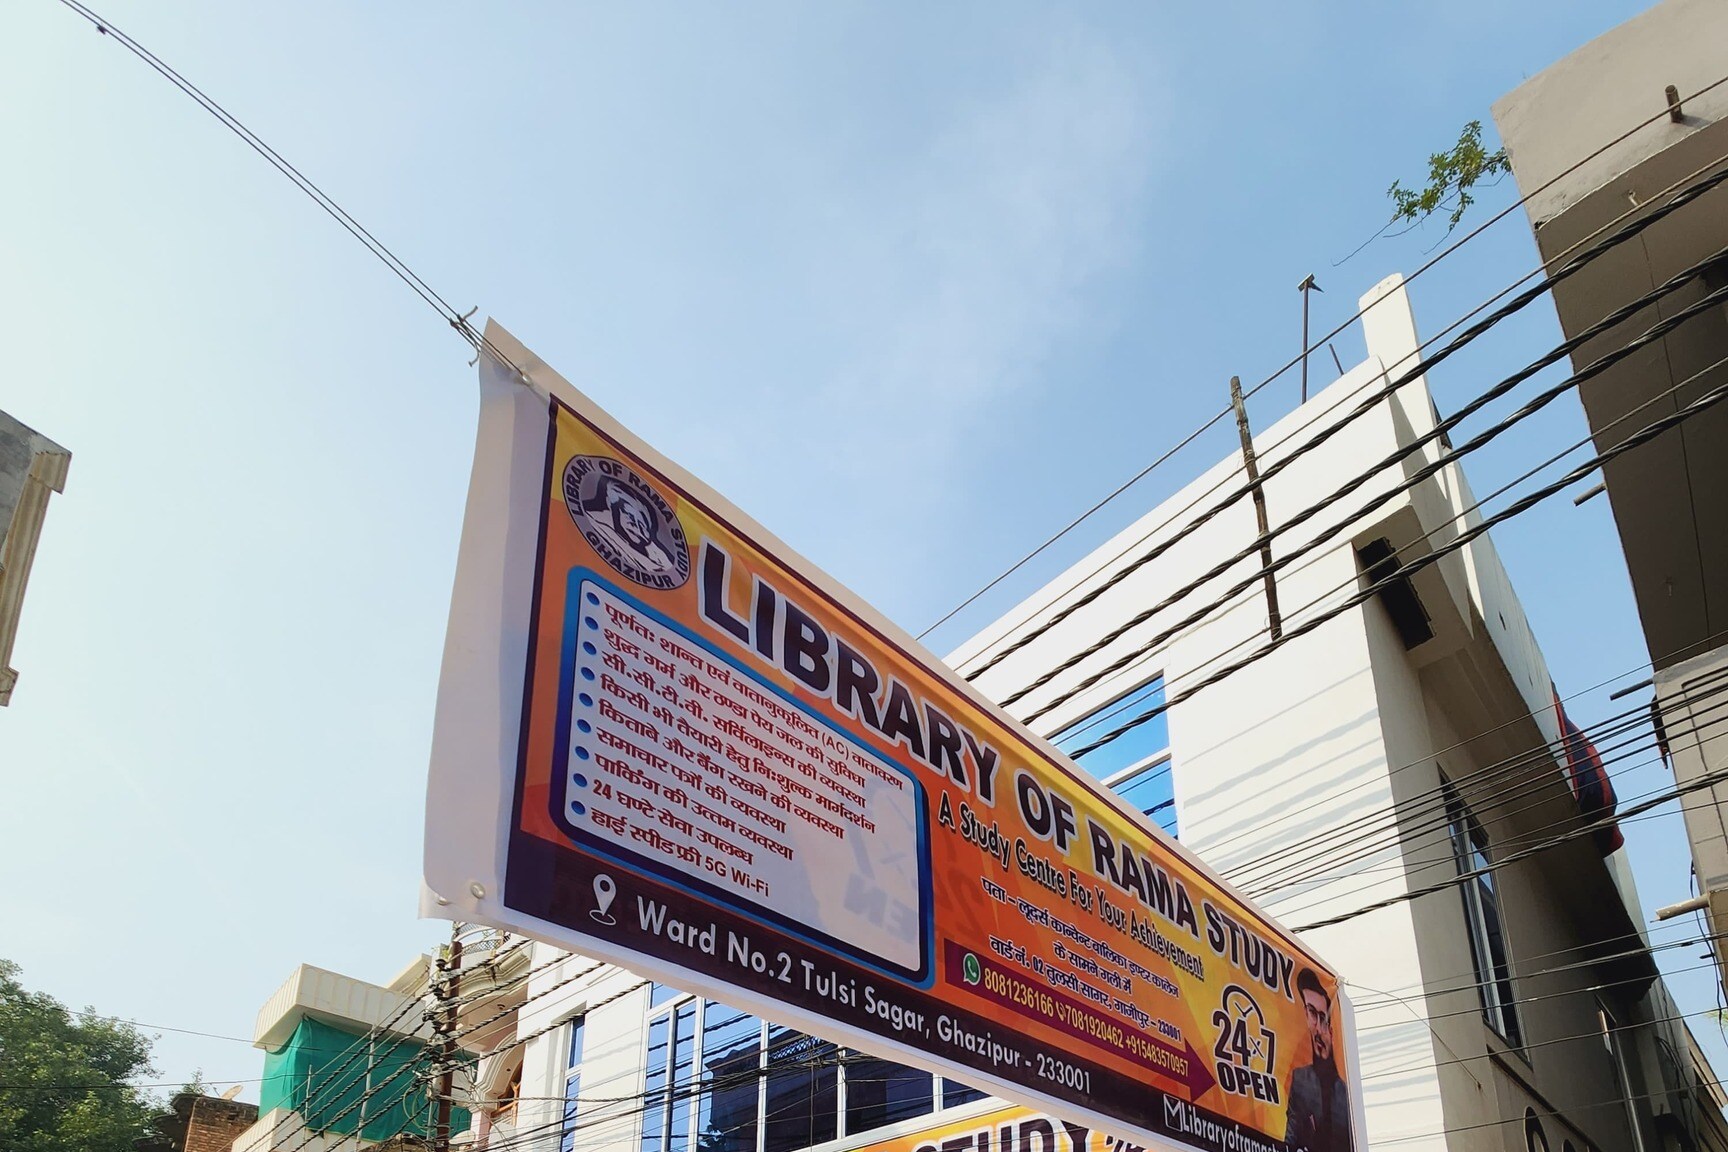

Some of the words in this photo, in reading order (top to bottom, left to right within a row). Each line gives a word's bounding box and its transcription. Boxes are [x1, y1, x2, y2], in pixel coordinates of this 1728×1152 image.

[566, 458, 597, 516] LIBRARY
[598, 460, 623, 478] OF
[628, 472, 674, 524] RAMA
[671, 528, 689, 580] STUDY
[585, 531, 676, 588] GHAZIPUR
[600, 673, 650, 713] किसी
[652, 704, 674, 728] भी
[675, 716, 724, 754] तैयारी
[725, 742, 751, 773] हेतु
[815, 792, 876, 834] मार्गदर्शन
[603, 628, 642, 660] शुद्ध
[643, 651, 676, 680] गर्म
[678, 673, 715, 700] और
[713, 691, 749, 720] ठण्डा
[750, 708, 774, 734] पेय
[776, 726, 804, 751] जल
[805, 743, 825, 763] की
[827, 757, 866, 788] सुविधा
[659, 637, 704, 671] शान्त
[706, 662, 731, 686] एवं
[732, 677, 820, 740] वातानुकूलित
[821, 732, 850, 760] (AC)
[852, 751, 903, 790] वातावरण
[596, 726, 669, 773] समाचार
[670, 762, 703, 791] पत्रों
[704, 782, 728, 805] की
[730, 796, 786, 834] व्यवस्था
[662, 736, 700, 763] और
[727, 770, 768, 801] रखने
[770, 791, 792, 813] की
[793, 803, 845, 839] व्यवस्था
[702, 540, 998, 804] LIBRARY
[1017, 771, 1077, 852] OF
[1090, 820, 1199, 939] RAMA
[1203, 900, 1295, 1000] STUDY
[797, 759, 818, 780] की
[819, 773, 866, 808] व्यवस्था
[590, 807, 628, 836] हाई
[629, 823, 675, 855] स्पीड
[676, 843, 702, 867] फ्री
[704, 857, 727, 878] 5G
[731, 866, 770, 898] Wi-Fi
[592, 779, 612, 800] 24
[616, 790, 656, 819] घण्टे
[657, 807, 694, 837] सेवा
[696, 826, 754, 865] उपलब्ध
[662, 784, 689, 809] की
[691, 799, 737, 833] उत्तम
[738, 823, 794, 861] व्यवस्था
[938, 790, 956, 833] A
[959, 801, 1011, 869] Study
[1015, 836, 1067, 898] Centre
[1068, 868, 1094, 914] For
[1094, 885, 1127, 935] Your
[1130, 909, 1205, 981] Achievement
[981, 876, 1006, 904] पता
[636, 895, 716, 955] Ward
[727, 931, 792, 984] No.2
[800, 959, 857, 1008] Tulsi
[864, 985, 930, 1040] Sagar,
[936, 1014, 1021, 1068] Ghazipur
[1036, 1053, 1091, 1094] 233001
[984, 967, 1054, 1018] 8081236166
[1065, 1004, 1124, 1049] 7081920462
[989, 934, 1014, 961] वार्ड
[1032, 955, 1045, 976] 02
[1045, 963, 1080, 996] तुलसी
[1053, 941, 1066, 960] के
[1067, 949, 1099, 977] सामने
[1099, 966, 1122, 990] गली
[1215, 1061, 1280, 1105] OPEN
